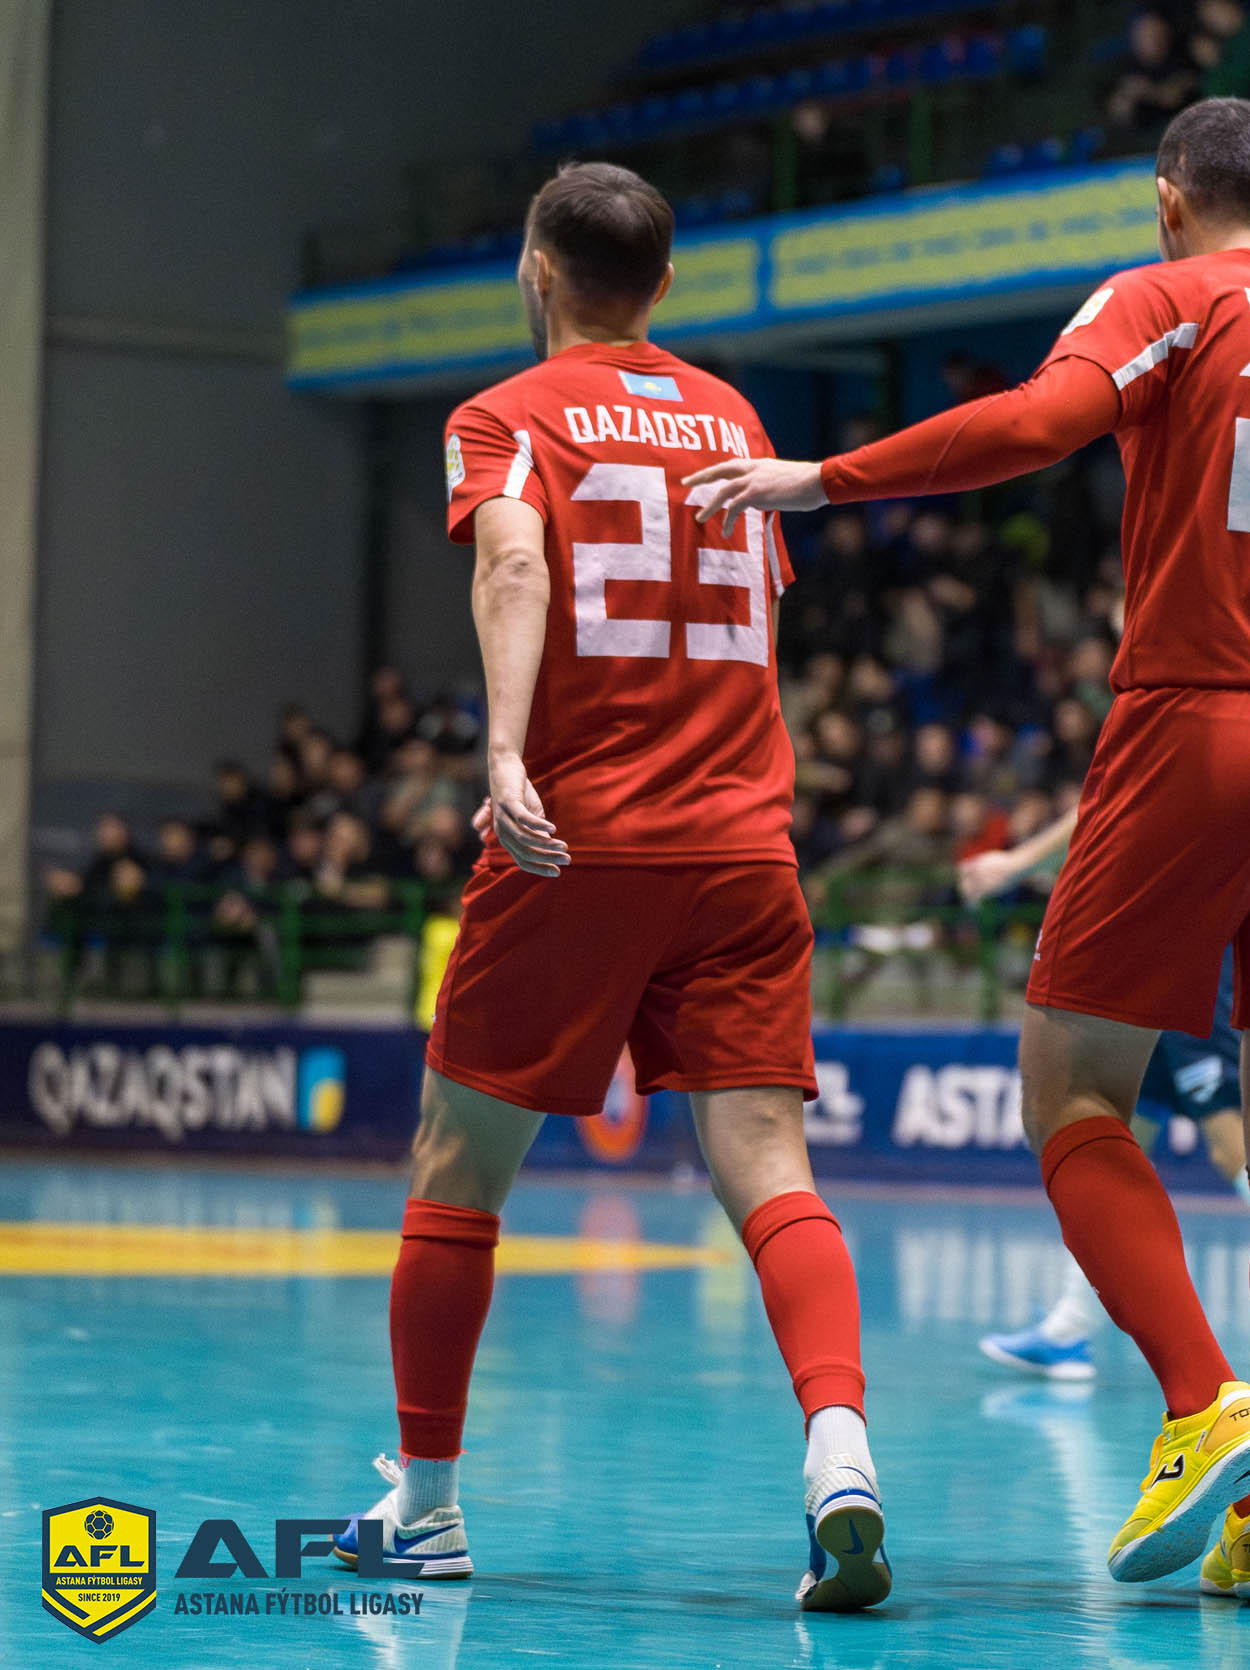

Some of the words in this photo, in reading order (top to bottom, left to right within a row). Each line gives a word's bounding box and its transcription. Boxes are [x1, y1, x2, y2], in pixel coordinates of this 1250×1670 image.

[564, 405, 751, 459] QAZAQSTAN
[571, 463, 769, 668] 23
[28, 1043, 297, 1142] QAZAQSTAN
